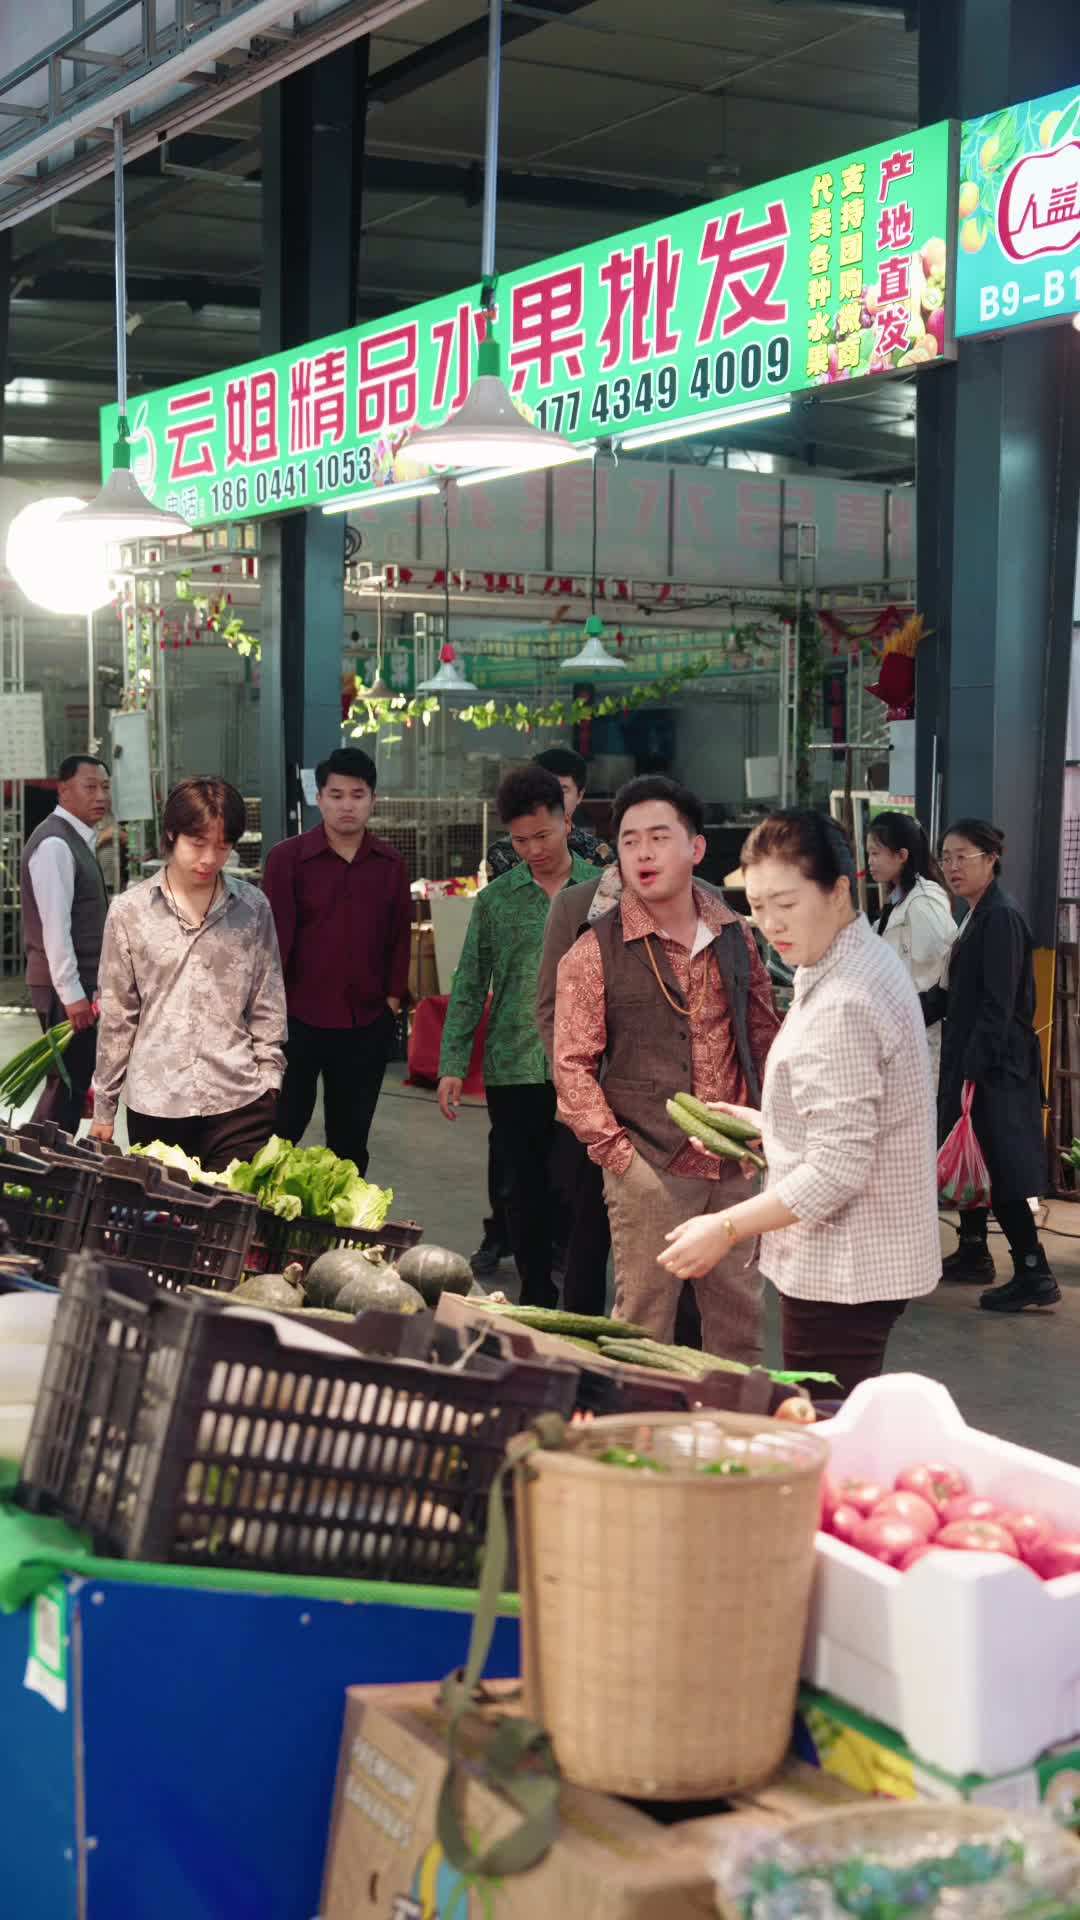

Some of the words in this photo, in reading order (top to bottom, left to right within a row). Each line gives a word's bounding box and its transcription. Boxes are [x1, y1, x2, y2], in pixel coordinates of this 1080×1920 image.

[166, 202, 789, 480] 云姐精品水果批发
[806, 172, 834, 377] 代卖各种水果
[838, 163, 866, 369] 支持团购微商
[876, 151, 914, 354] 产地直发
[210, 479, 247, 513] 186
[256, 464, 307, 503] 0441
[316, 446, 372, 488] 1053
[536, 391, 581, 433] 177
[591, 367, 678, 423] 4349
[690, 336, 790, 399] 4009
